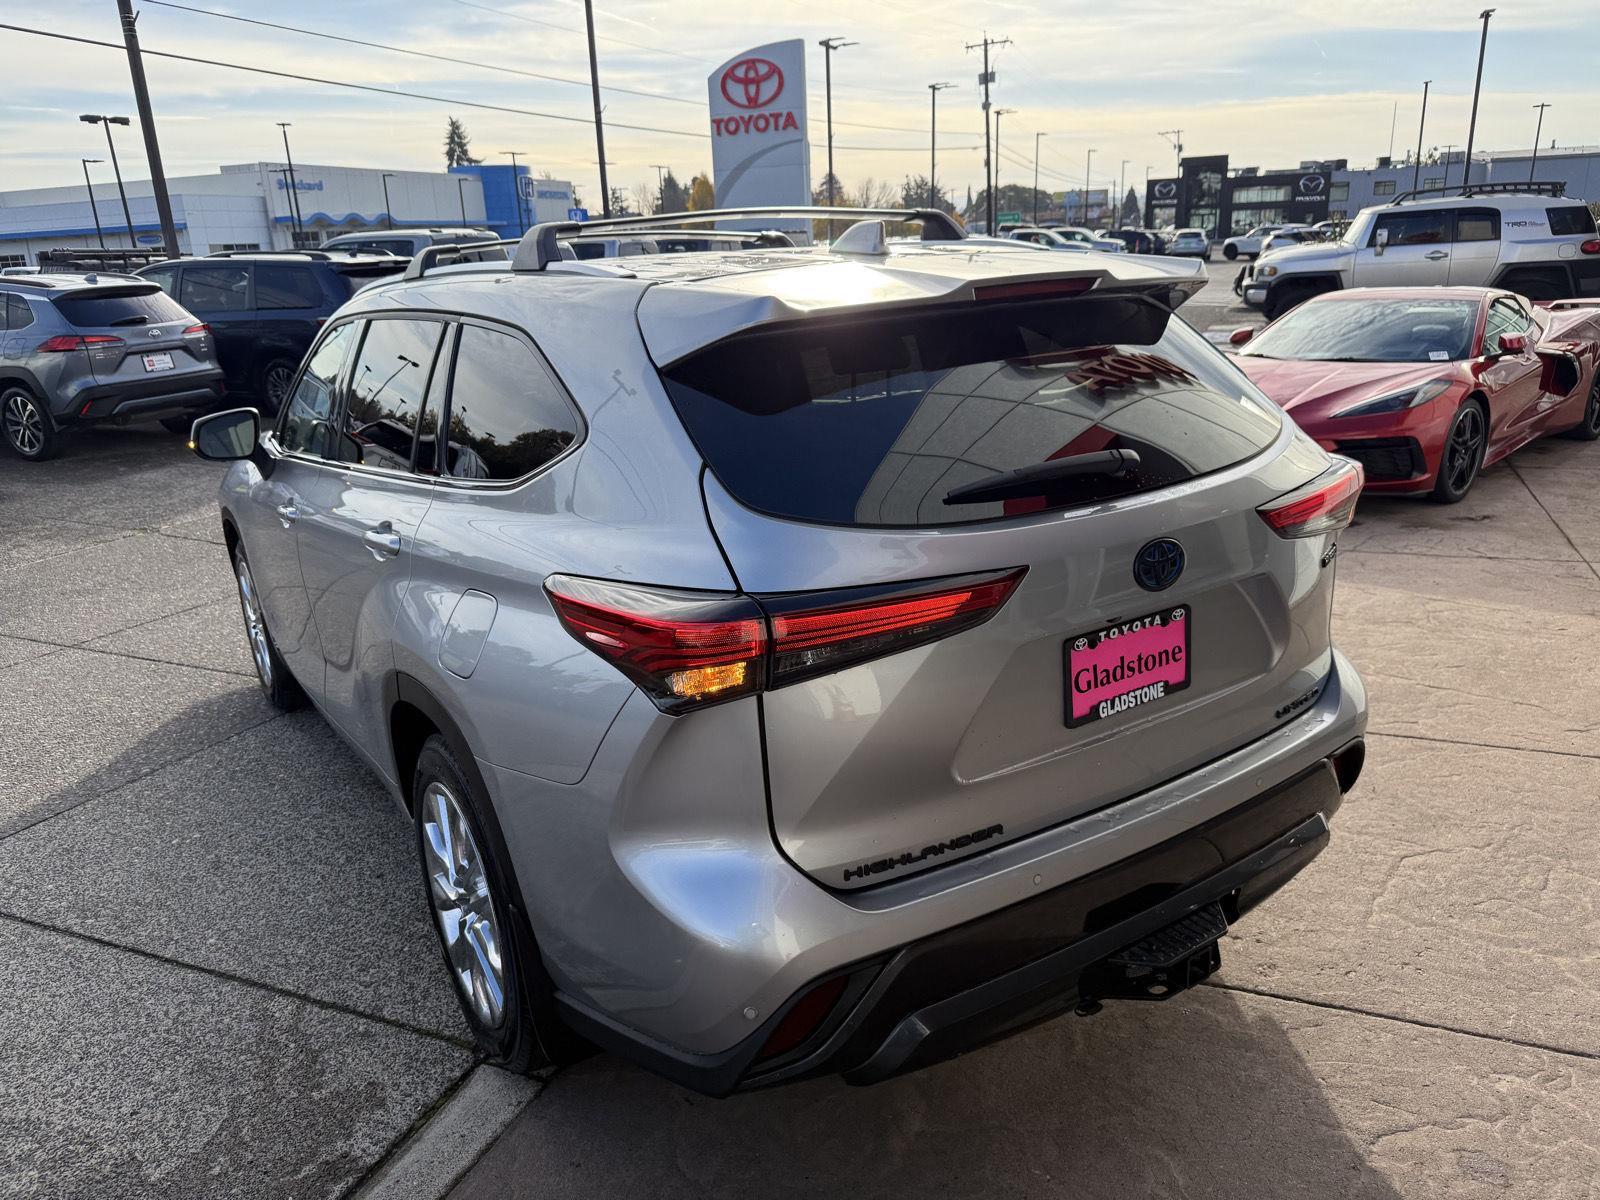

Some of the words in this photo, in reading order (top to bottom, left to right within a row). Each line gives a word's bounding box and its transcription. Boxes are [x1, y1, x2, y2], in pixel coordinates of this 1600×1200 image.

[711, 111, 799, 137] TOYOTA
[1504, 220, 1527, 228] TRD
[1098, 614, 1162, 642] TOYOTA
[1073, 645, 1183, 694] Gladstone
[1098, 681, 1165, 719] GLADSTONE
[843, 823, 1004, 882] HIGHLANDER
